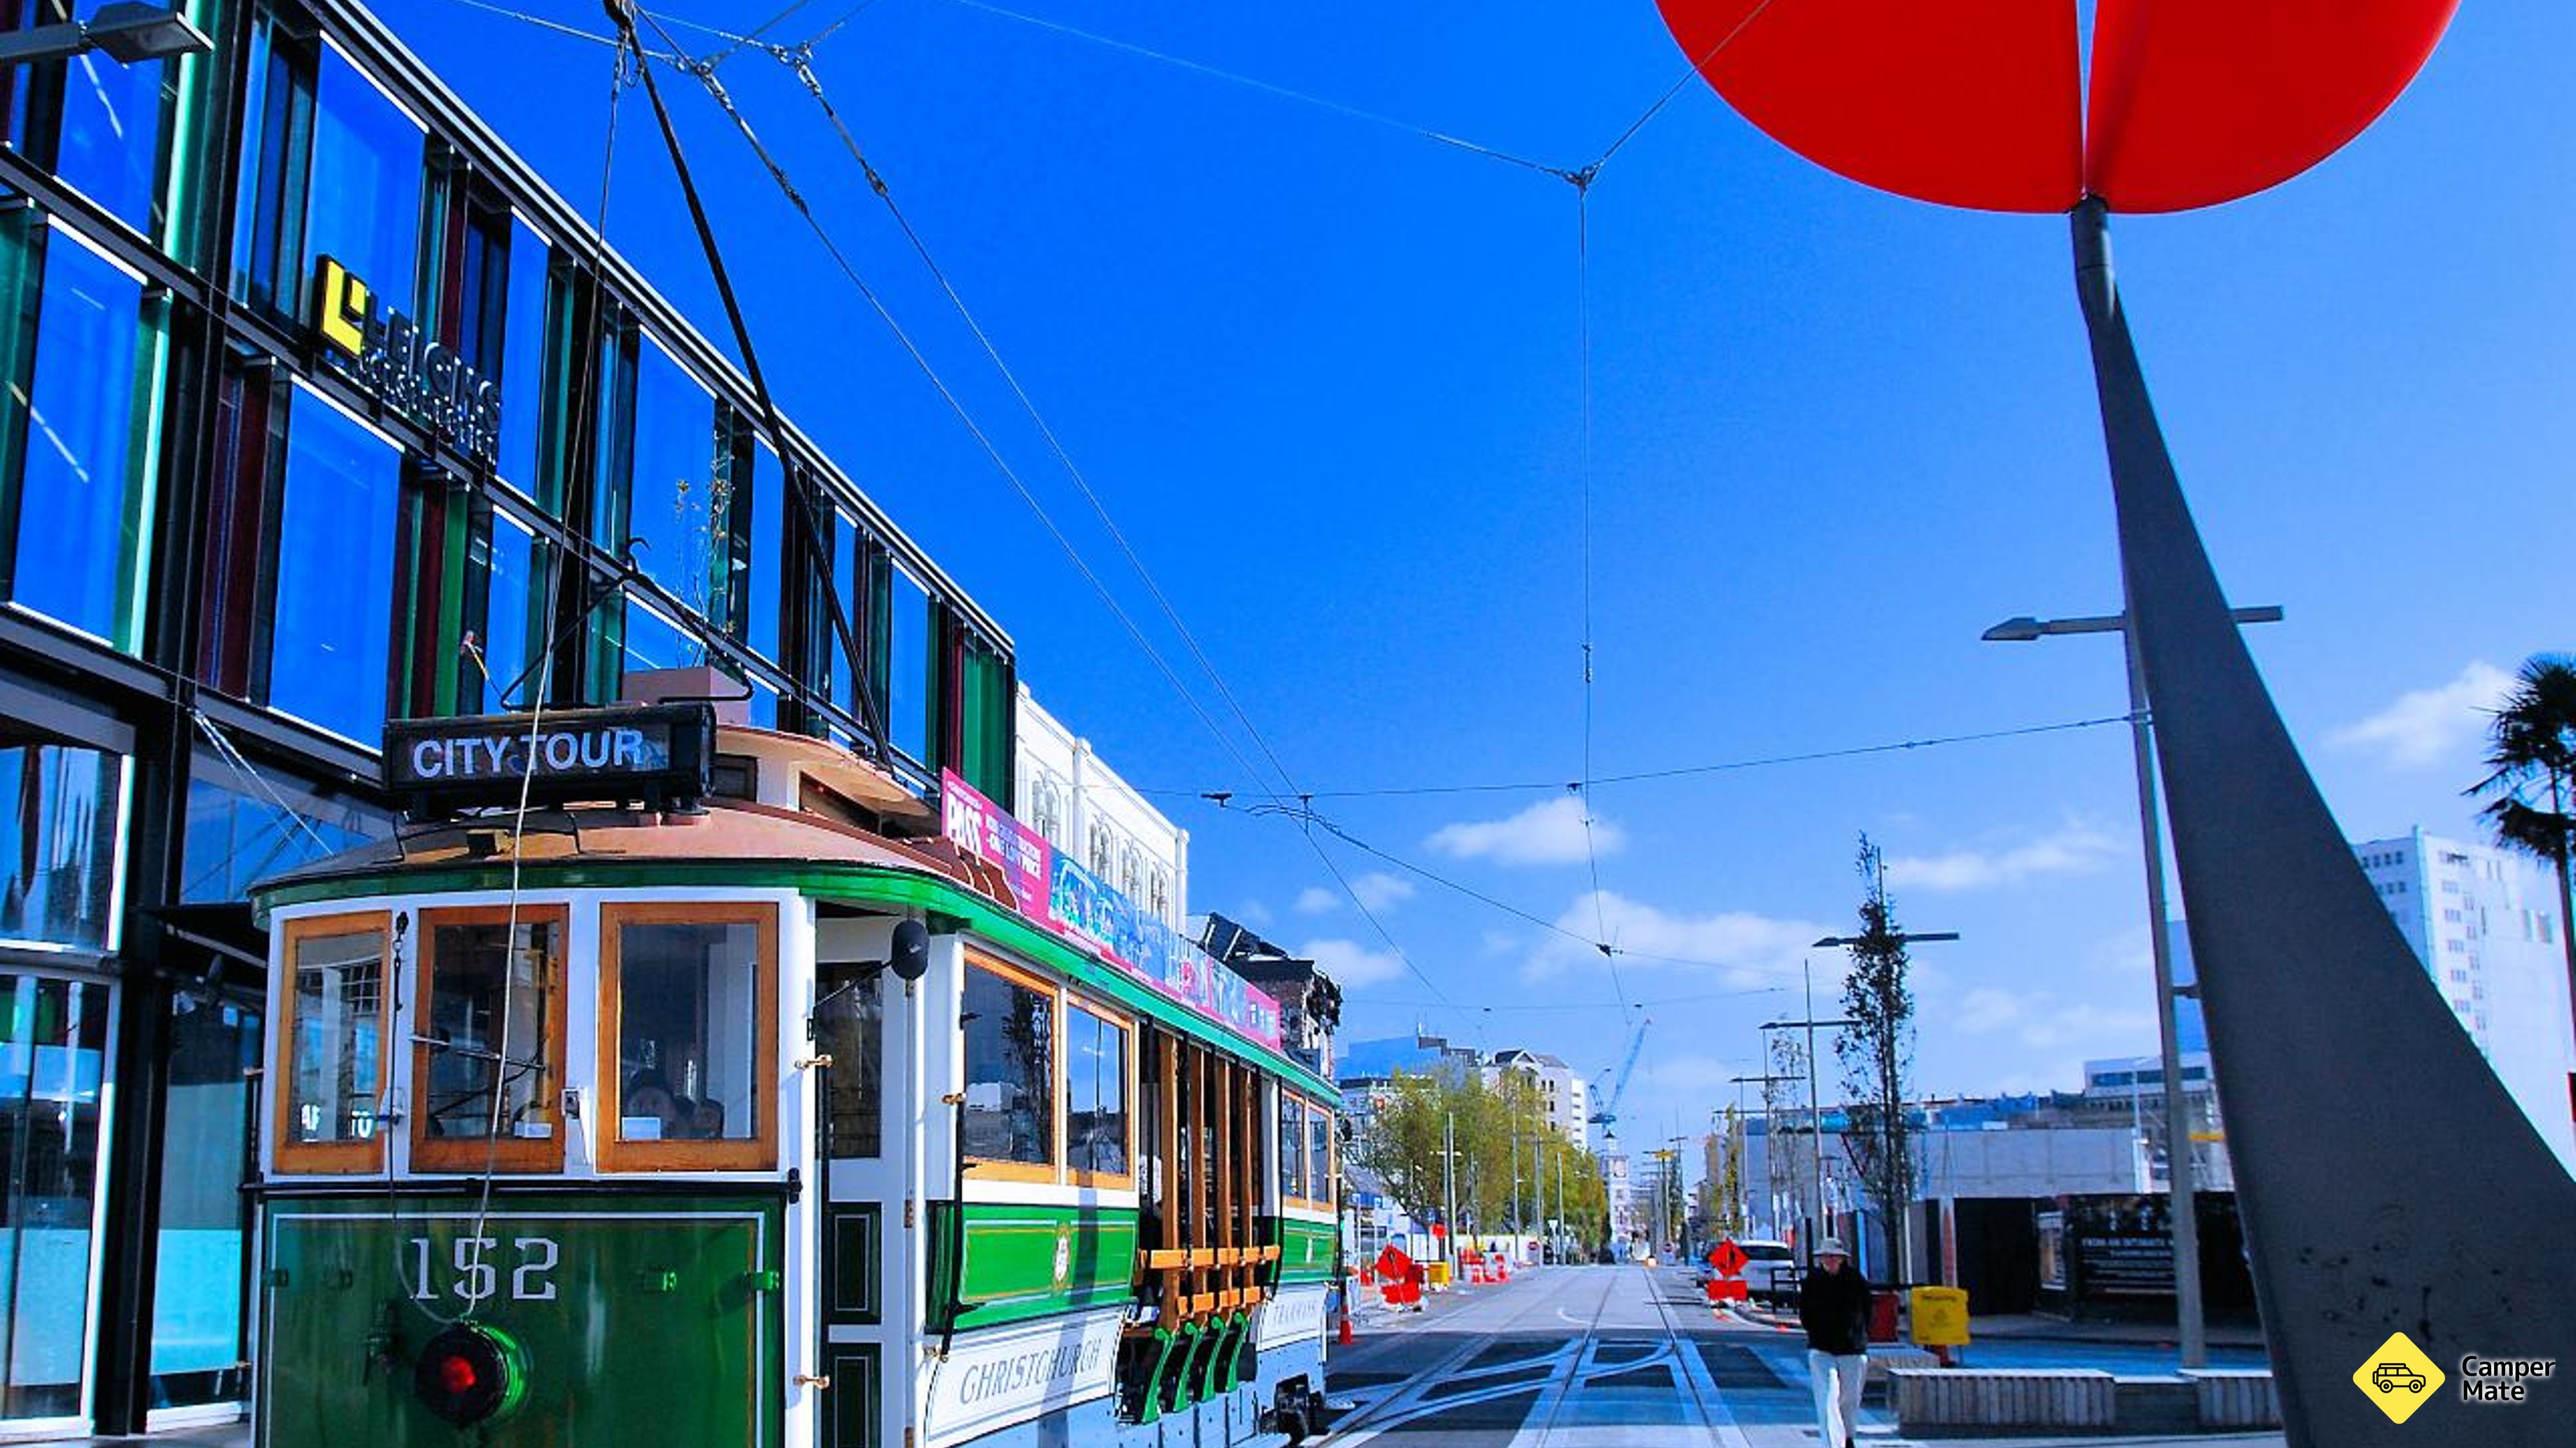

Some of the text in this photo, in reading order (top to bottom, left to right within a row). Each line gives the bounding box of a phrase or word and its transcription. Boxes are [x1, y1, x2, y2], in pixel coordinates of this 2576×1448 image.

[413, 727, 644, 778] CITY TOUR
[947, 792, 983, 857] PASS
[410, 1237, 558, 1299] 152
[960, 1338, 1101, 1405] CHRISTCHURCH
